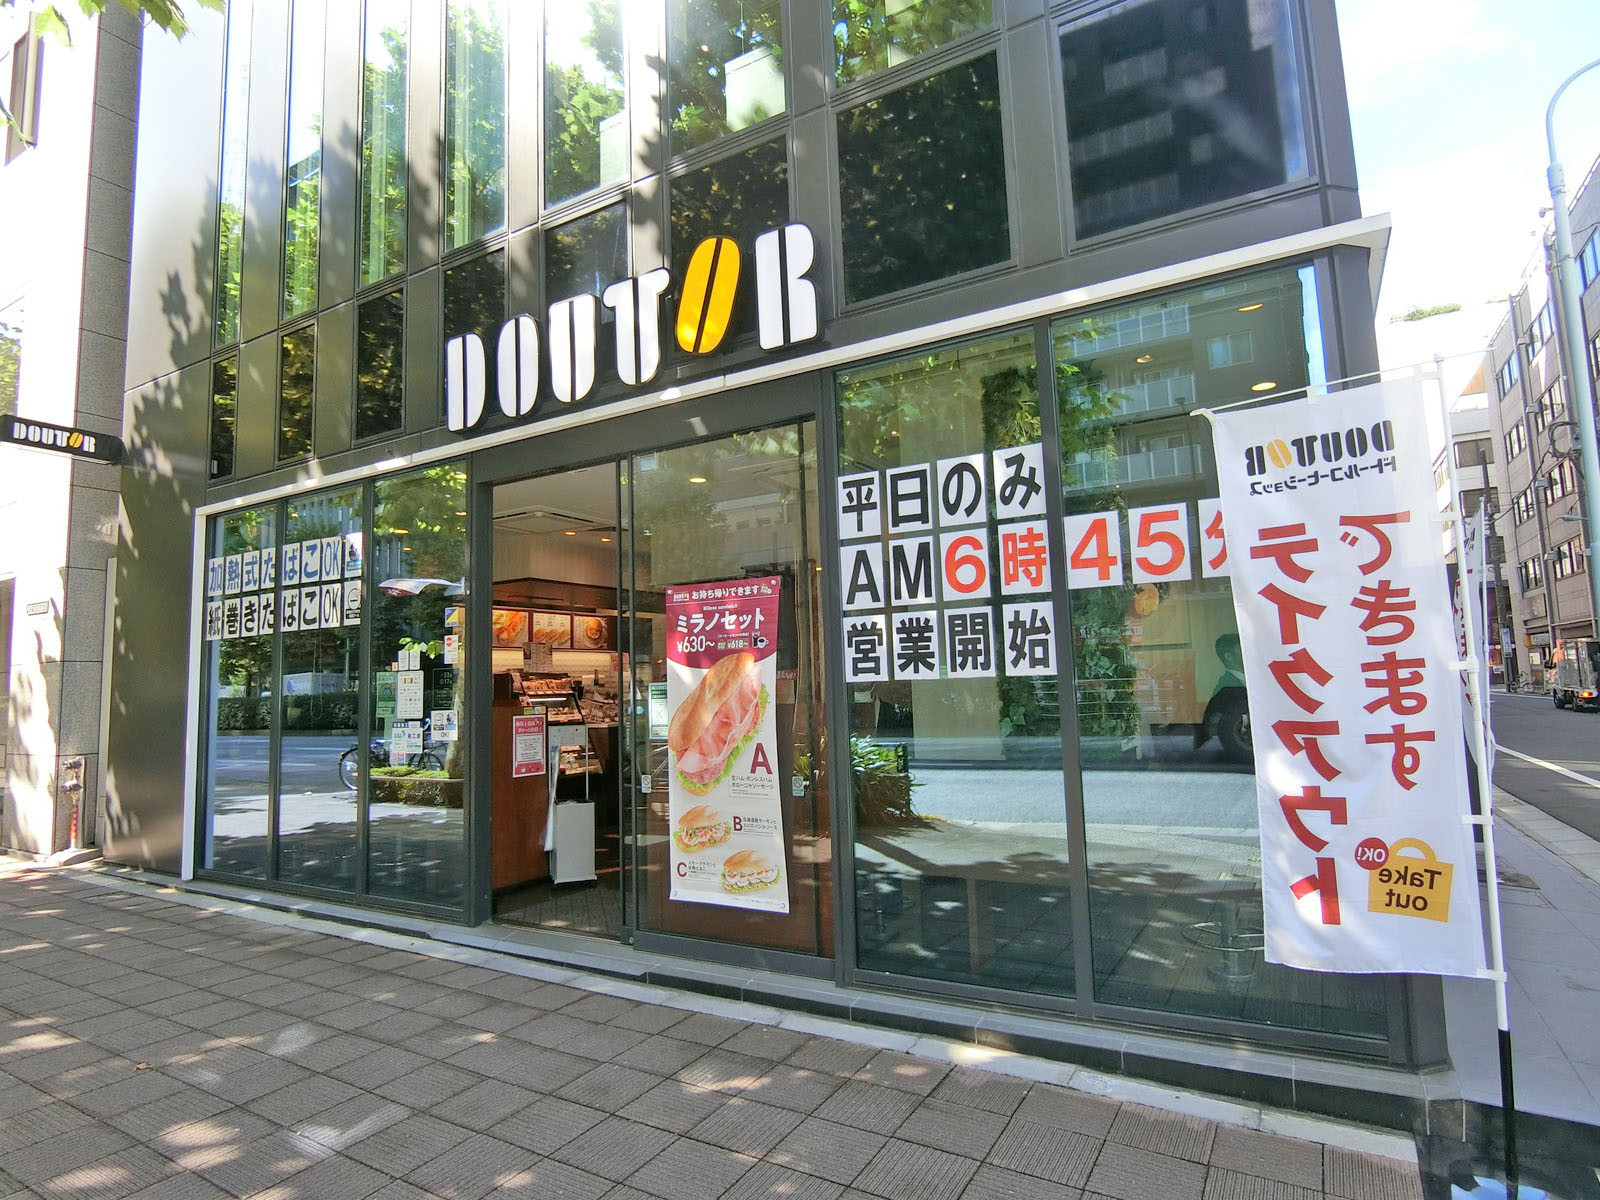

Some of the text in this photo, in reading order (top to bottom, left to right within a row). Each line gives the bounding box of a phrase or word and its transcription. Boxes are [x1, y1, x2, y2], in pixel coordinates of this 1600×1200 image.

[446, 222, 818, 432] DOUTOR
[13, 422, 96, 453] DOUTOR
[842, 452, 1042, 532] 平日のみ
[209, 539, 340, 593] 加熱式たばこOK
[692, 585, 760, 599] お持ち帰りできます
[207, 588, 340, 636] 紙巻きたばこOK
[677, 608, 765, 633] ミラノセット
[847, 608, 1051, 677] 営業開始
[750, 742, 773, 775] A
[733, 816, 743, 831] B
[677, 861, 687, 877] C
